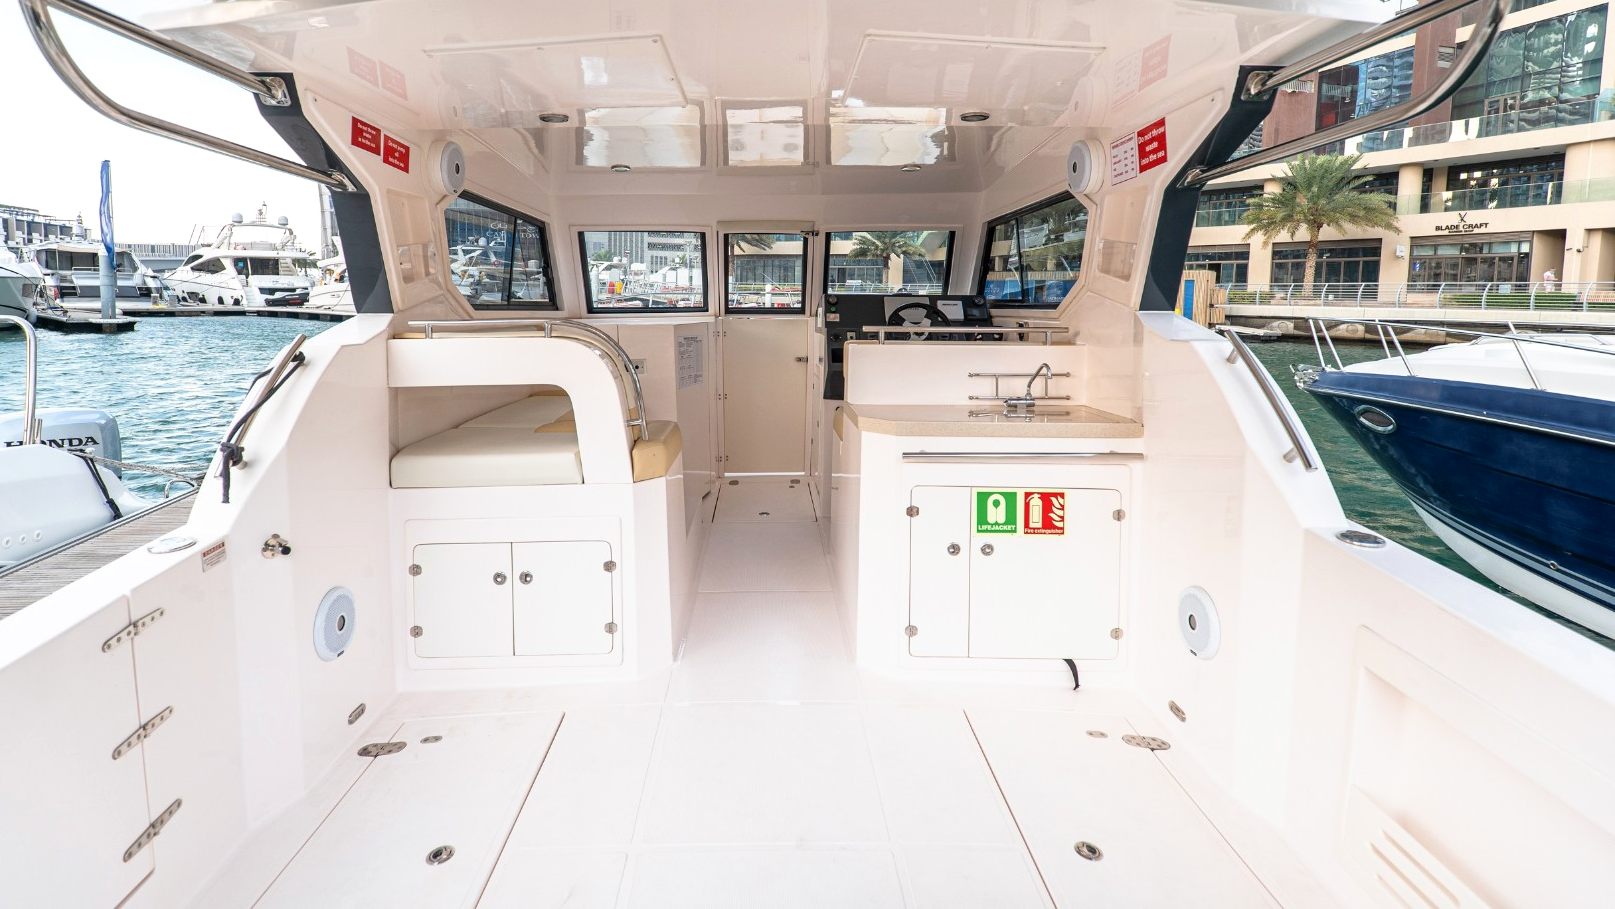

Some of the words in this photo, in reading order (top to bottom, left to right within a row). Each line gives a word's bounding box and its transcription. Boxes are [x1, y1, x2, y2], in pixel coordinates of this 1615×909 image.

[1137, 136, 1144, 144] Do
[1151, 126, 1165, 136] throw
[1145, 141, 1158, 152] waste
[1140, 157, 1149, 166] into
[1149, 154, 1157, 162] the
[1157, 150, 1165, 158] sea
[1435, 224, 1461, 232] BLADE
[1462, 222, 1489, 230] CRAFT
[4, 436, 99, 448] HNDA
